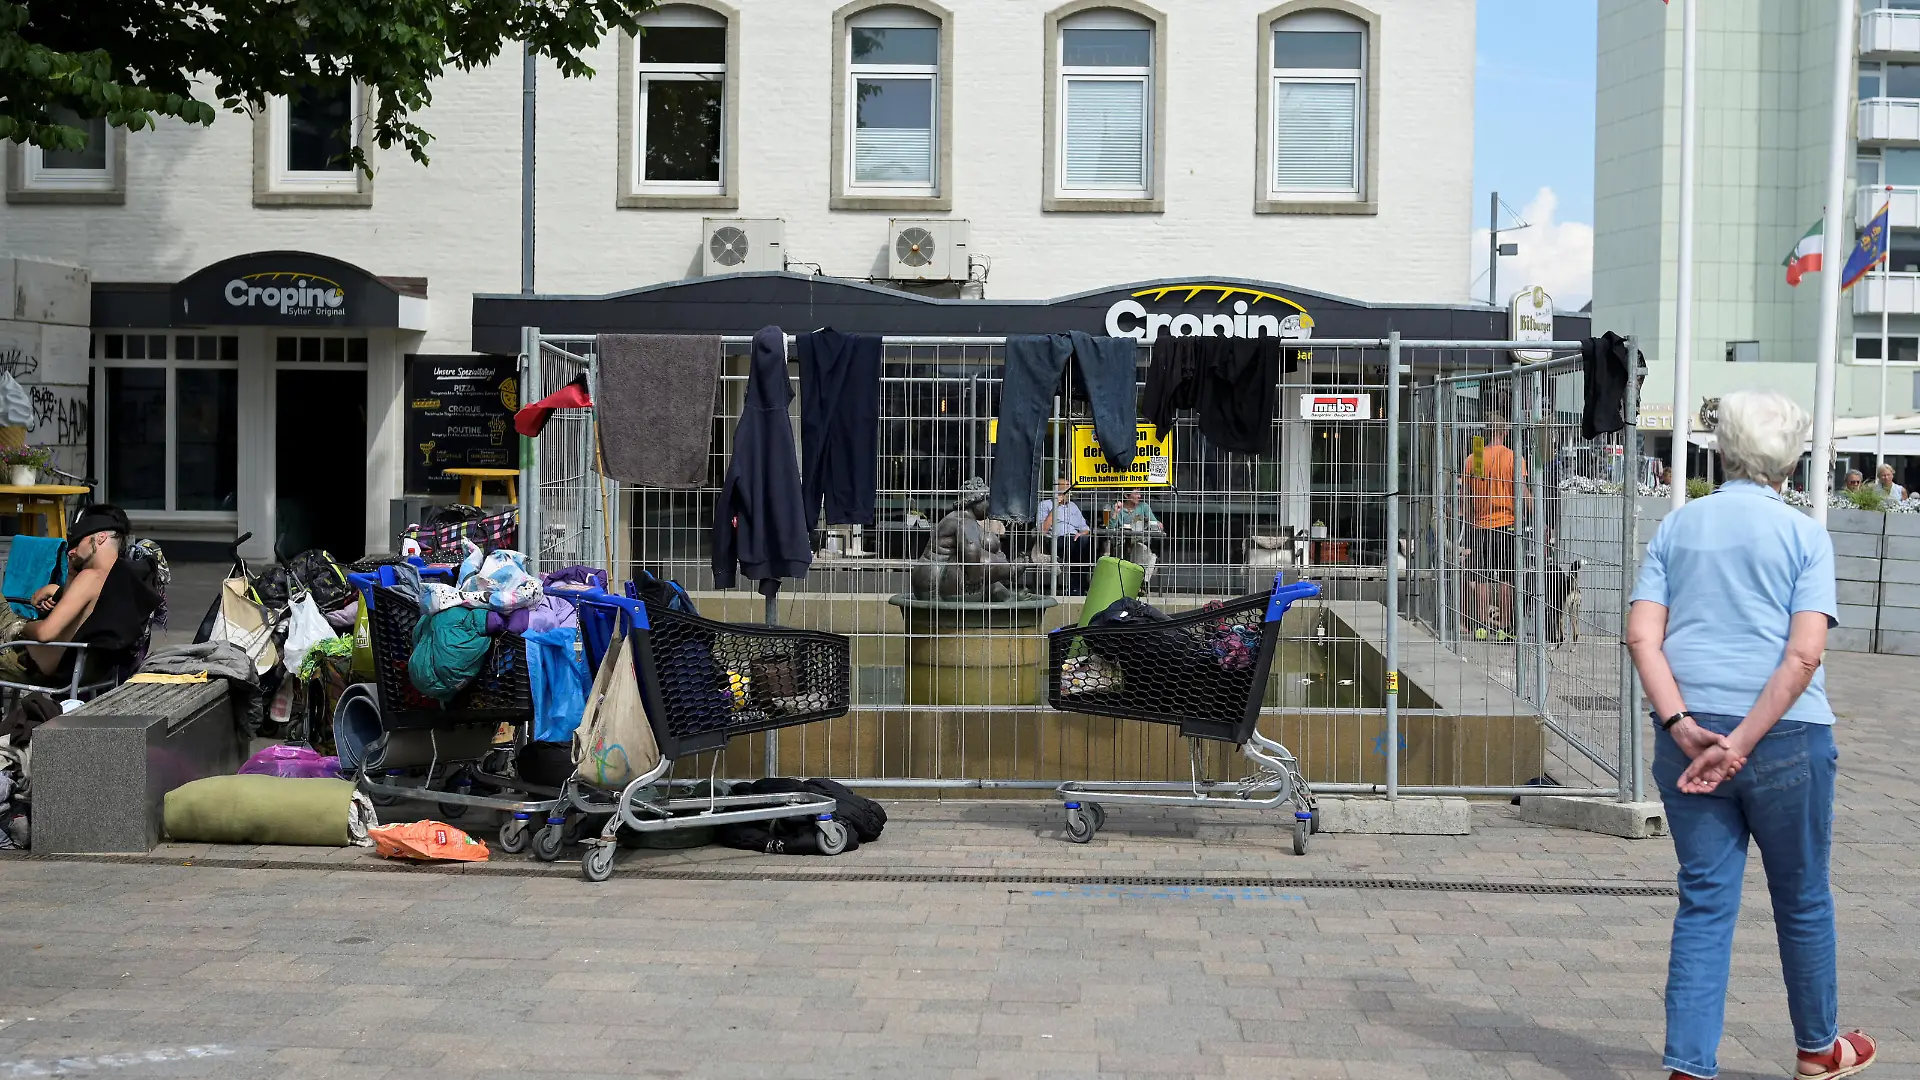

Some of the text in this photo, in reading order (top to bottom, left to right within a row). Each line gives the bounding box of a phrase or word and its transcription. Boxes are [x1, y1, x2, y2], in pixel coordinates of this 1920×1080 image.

[225, 279, 344, 314] Cropino
[288, 307, 345, 317] Sylter Original
[1519, 315, 1551, 335] Bitburger
[433, 367, 456, 376] Unsere
[453, 384, 476, 392] PIZZA
[448, 405, 481, 413] CROQUE
[447, 426, 482, 434] POUTINE
[1083, 445, 1104, 457] der
[1094, 461, 1151, 473] veren!
[1079, 475, 1097, 483] Eltern
[1119, 474, 1129, 482] für
